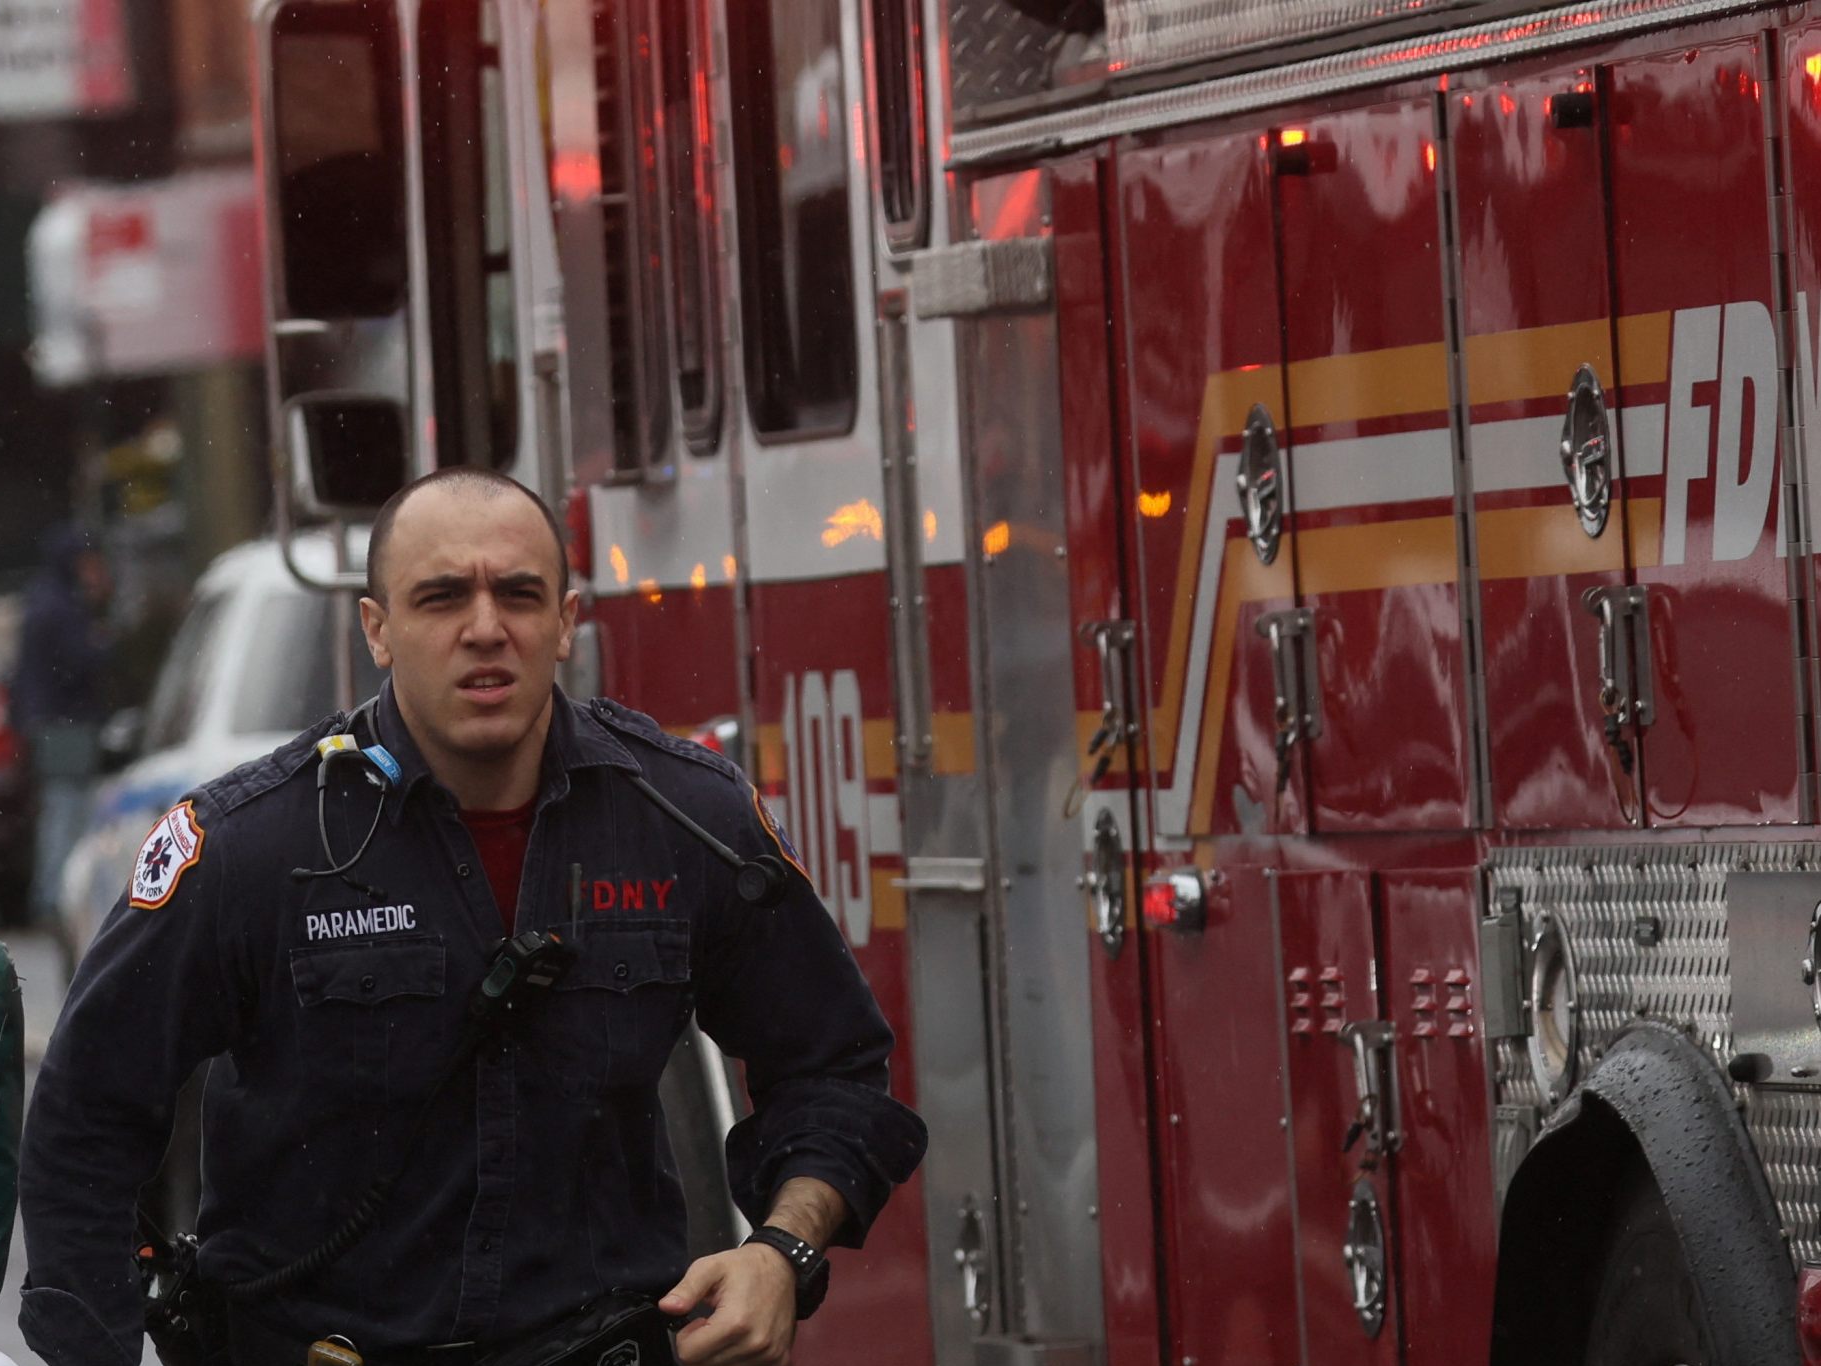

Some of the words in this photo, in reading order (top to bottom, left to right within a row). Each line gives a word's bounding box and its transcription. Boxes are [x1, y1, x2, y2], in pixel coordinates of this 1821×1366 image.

[781, 668, 873, 946] 109
[144, 884, 164, 897] YORK
[306, 904, 417, 942] PARAMEDIC
